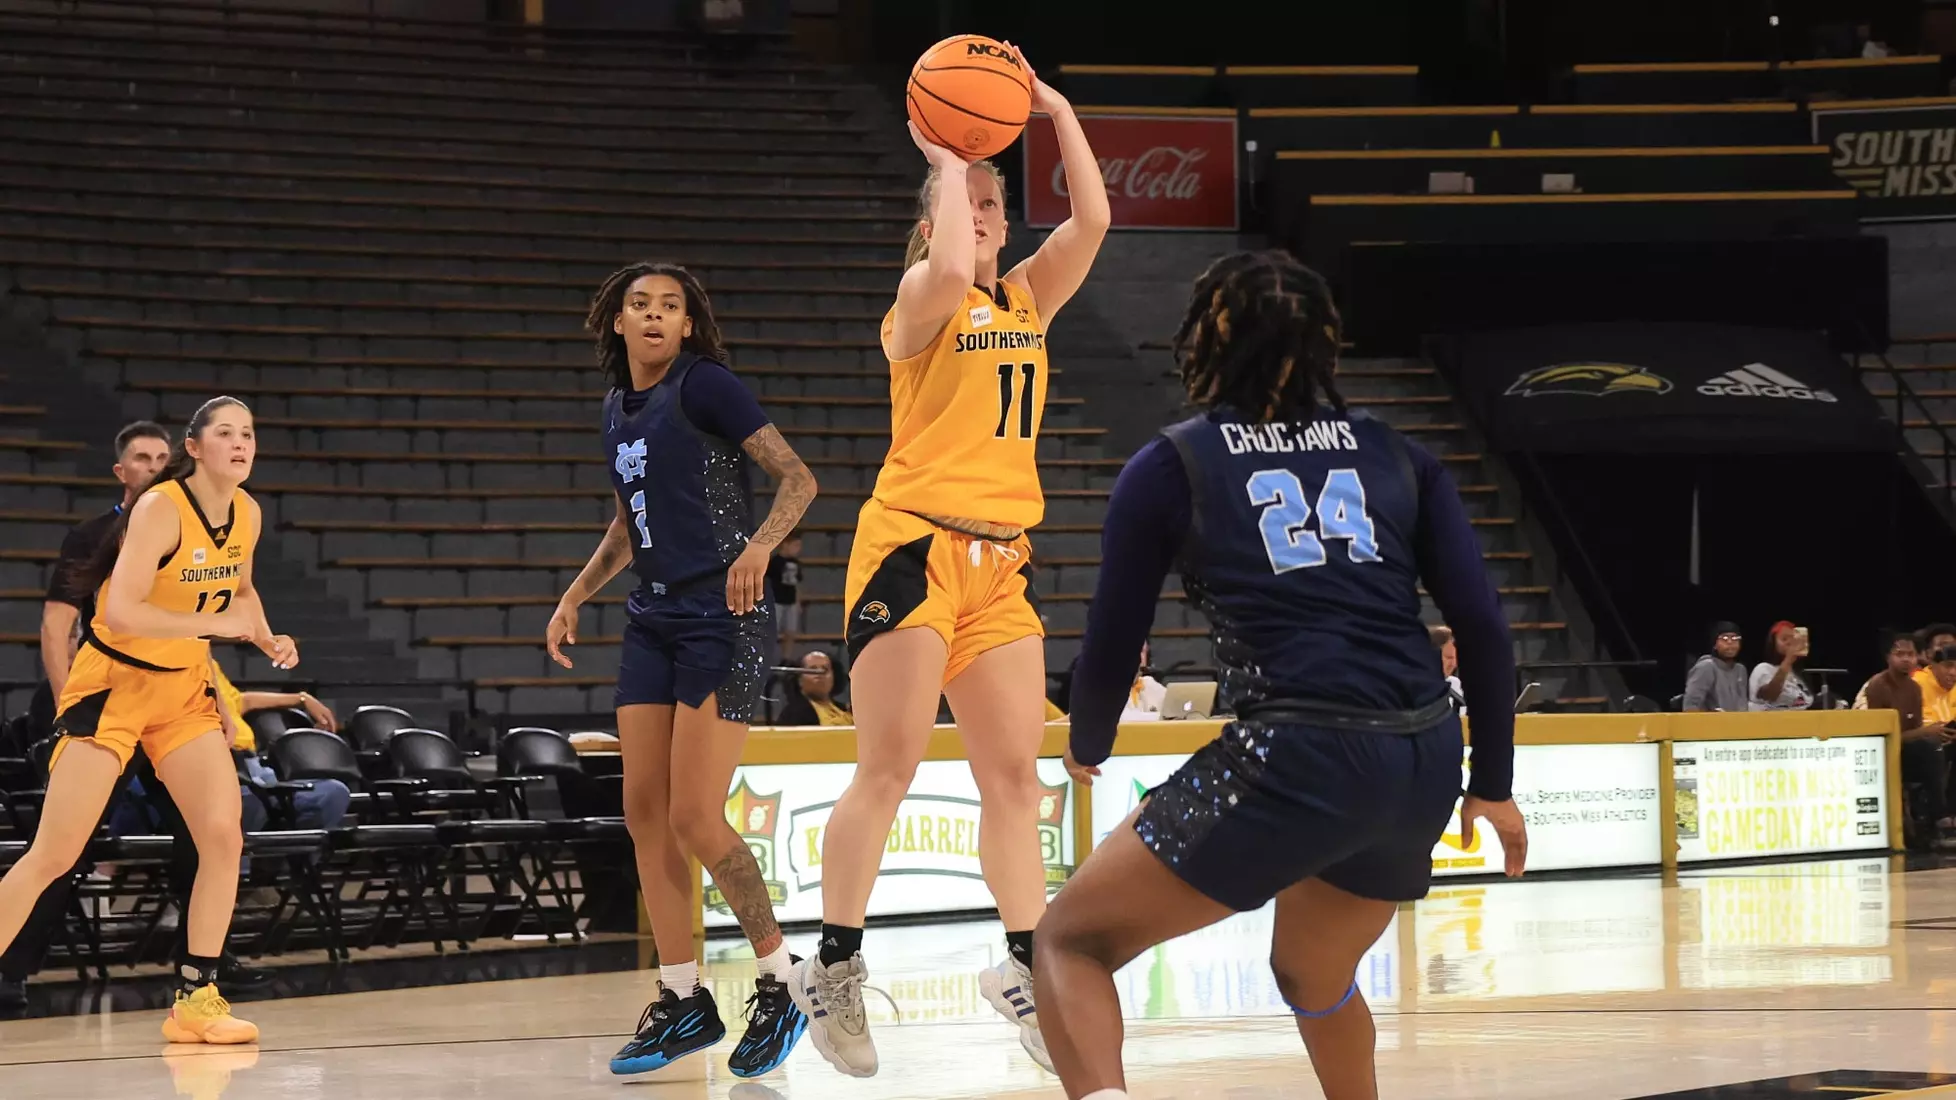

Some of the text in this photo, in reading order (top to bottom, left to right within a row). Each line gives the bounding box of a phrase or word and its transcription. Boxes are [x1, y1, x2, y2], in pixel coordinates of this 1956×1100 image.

[966, 43, 1022, 72] NCAA
[1832, 128, 1956, 167] SOUTH
[1883, 164, 1956, 198] MISS
[993, 362, 1036, 439] 11
[1697, 383, 1838, 402] adidas
[1246, 468, 1383, 575] 24
[179, 565, 231, 583] SOUTHERN
[1754, 745, 1788, 760] dedicated
[1538, 789, 1570, 804] SPORTS
[1615, 787, 1656, 801] PROVIDER
[1706, 765, 1847, 803] SOUTHERN MISS
[886, 815, 978, 858] BARREL
[1706, 803, 1848, 854] GAMEDAY APP
